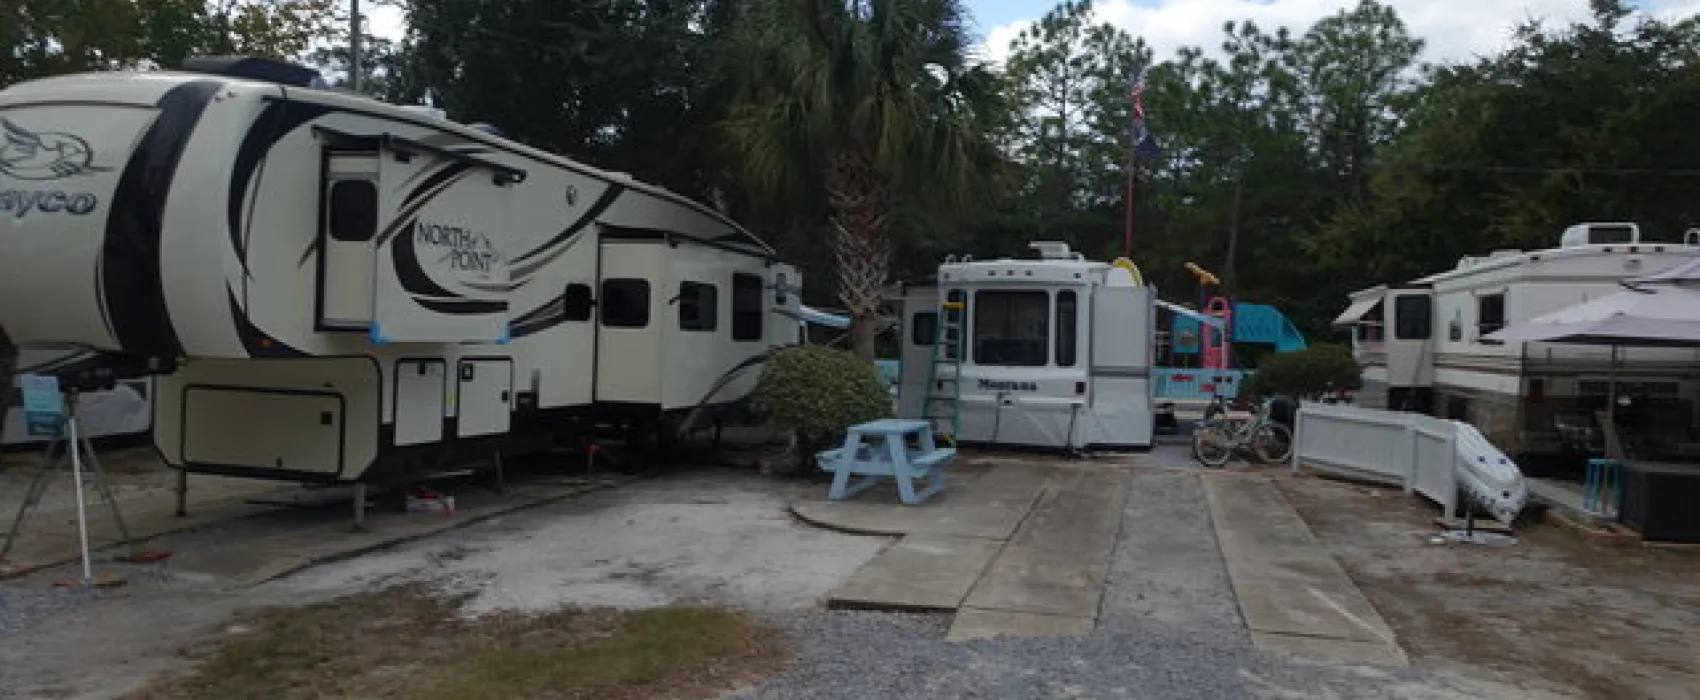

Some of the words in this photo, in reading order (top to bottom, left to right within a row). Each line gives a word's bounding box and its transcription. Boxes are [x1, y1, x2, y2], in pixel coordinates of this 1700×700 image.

[417, 222, 471, 249] NORTH
[451, 248, 492, 273] POINT
[977, 379, 1038, 393] Montana
